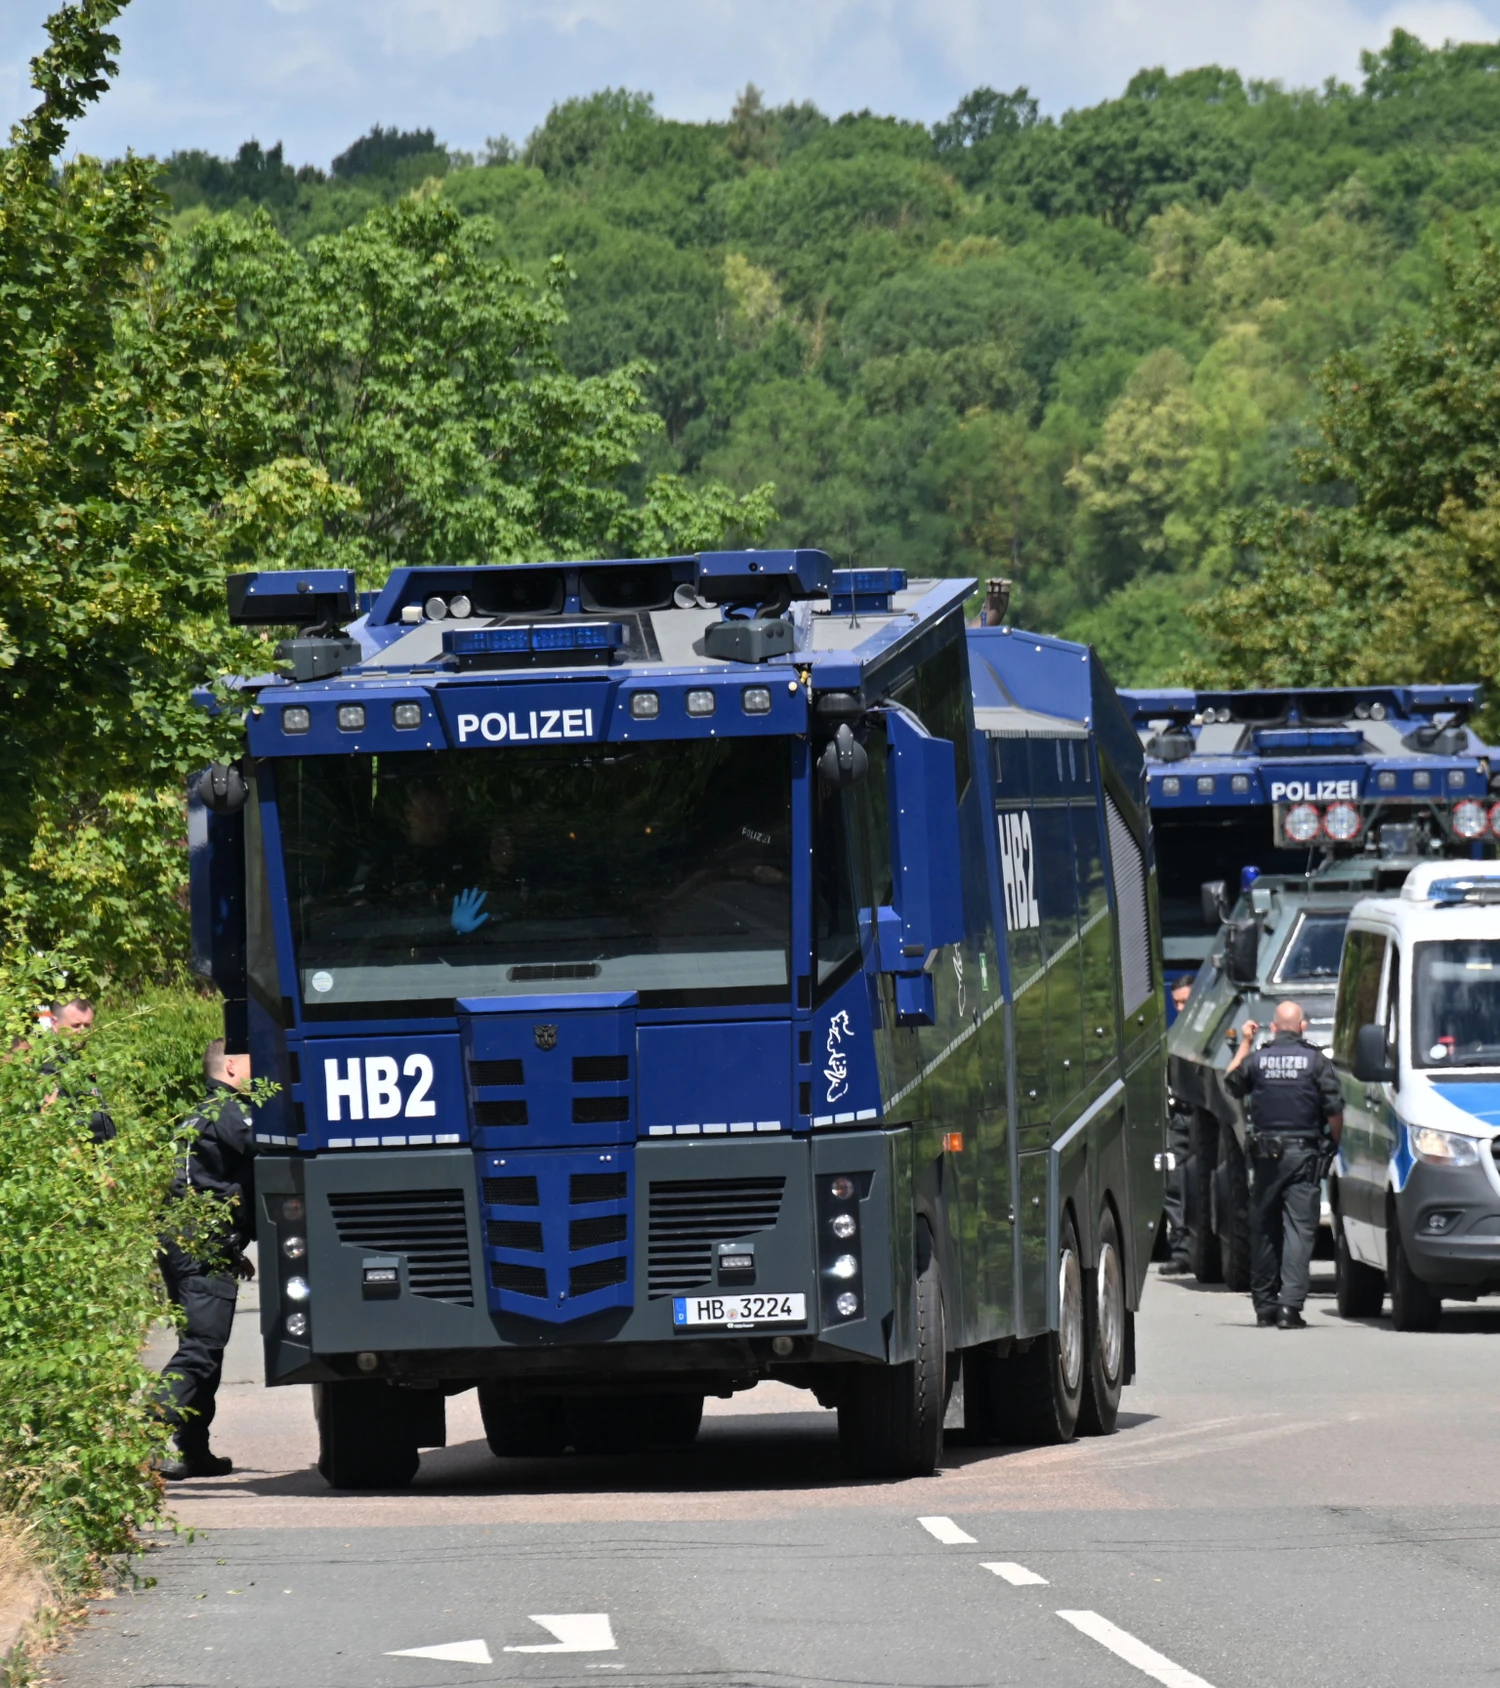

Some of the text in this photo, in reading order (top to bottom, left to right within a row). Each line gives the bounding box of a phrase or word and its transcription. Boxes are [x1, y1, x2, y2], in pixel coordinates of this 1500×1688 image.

[457, 708, 593, 742] POLIZEI
[1271, 780, 1358, 801] POLIZEI
[741, 827, 771, 845] POLIZEI
[997, 810, 1040, 932] HB2
[1259, 1056, 1308, 1070] POLIZEI
[324, 1053, 436, 1121] HB2
[697, 1297, 792, 1320] HB 3224
